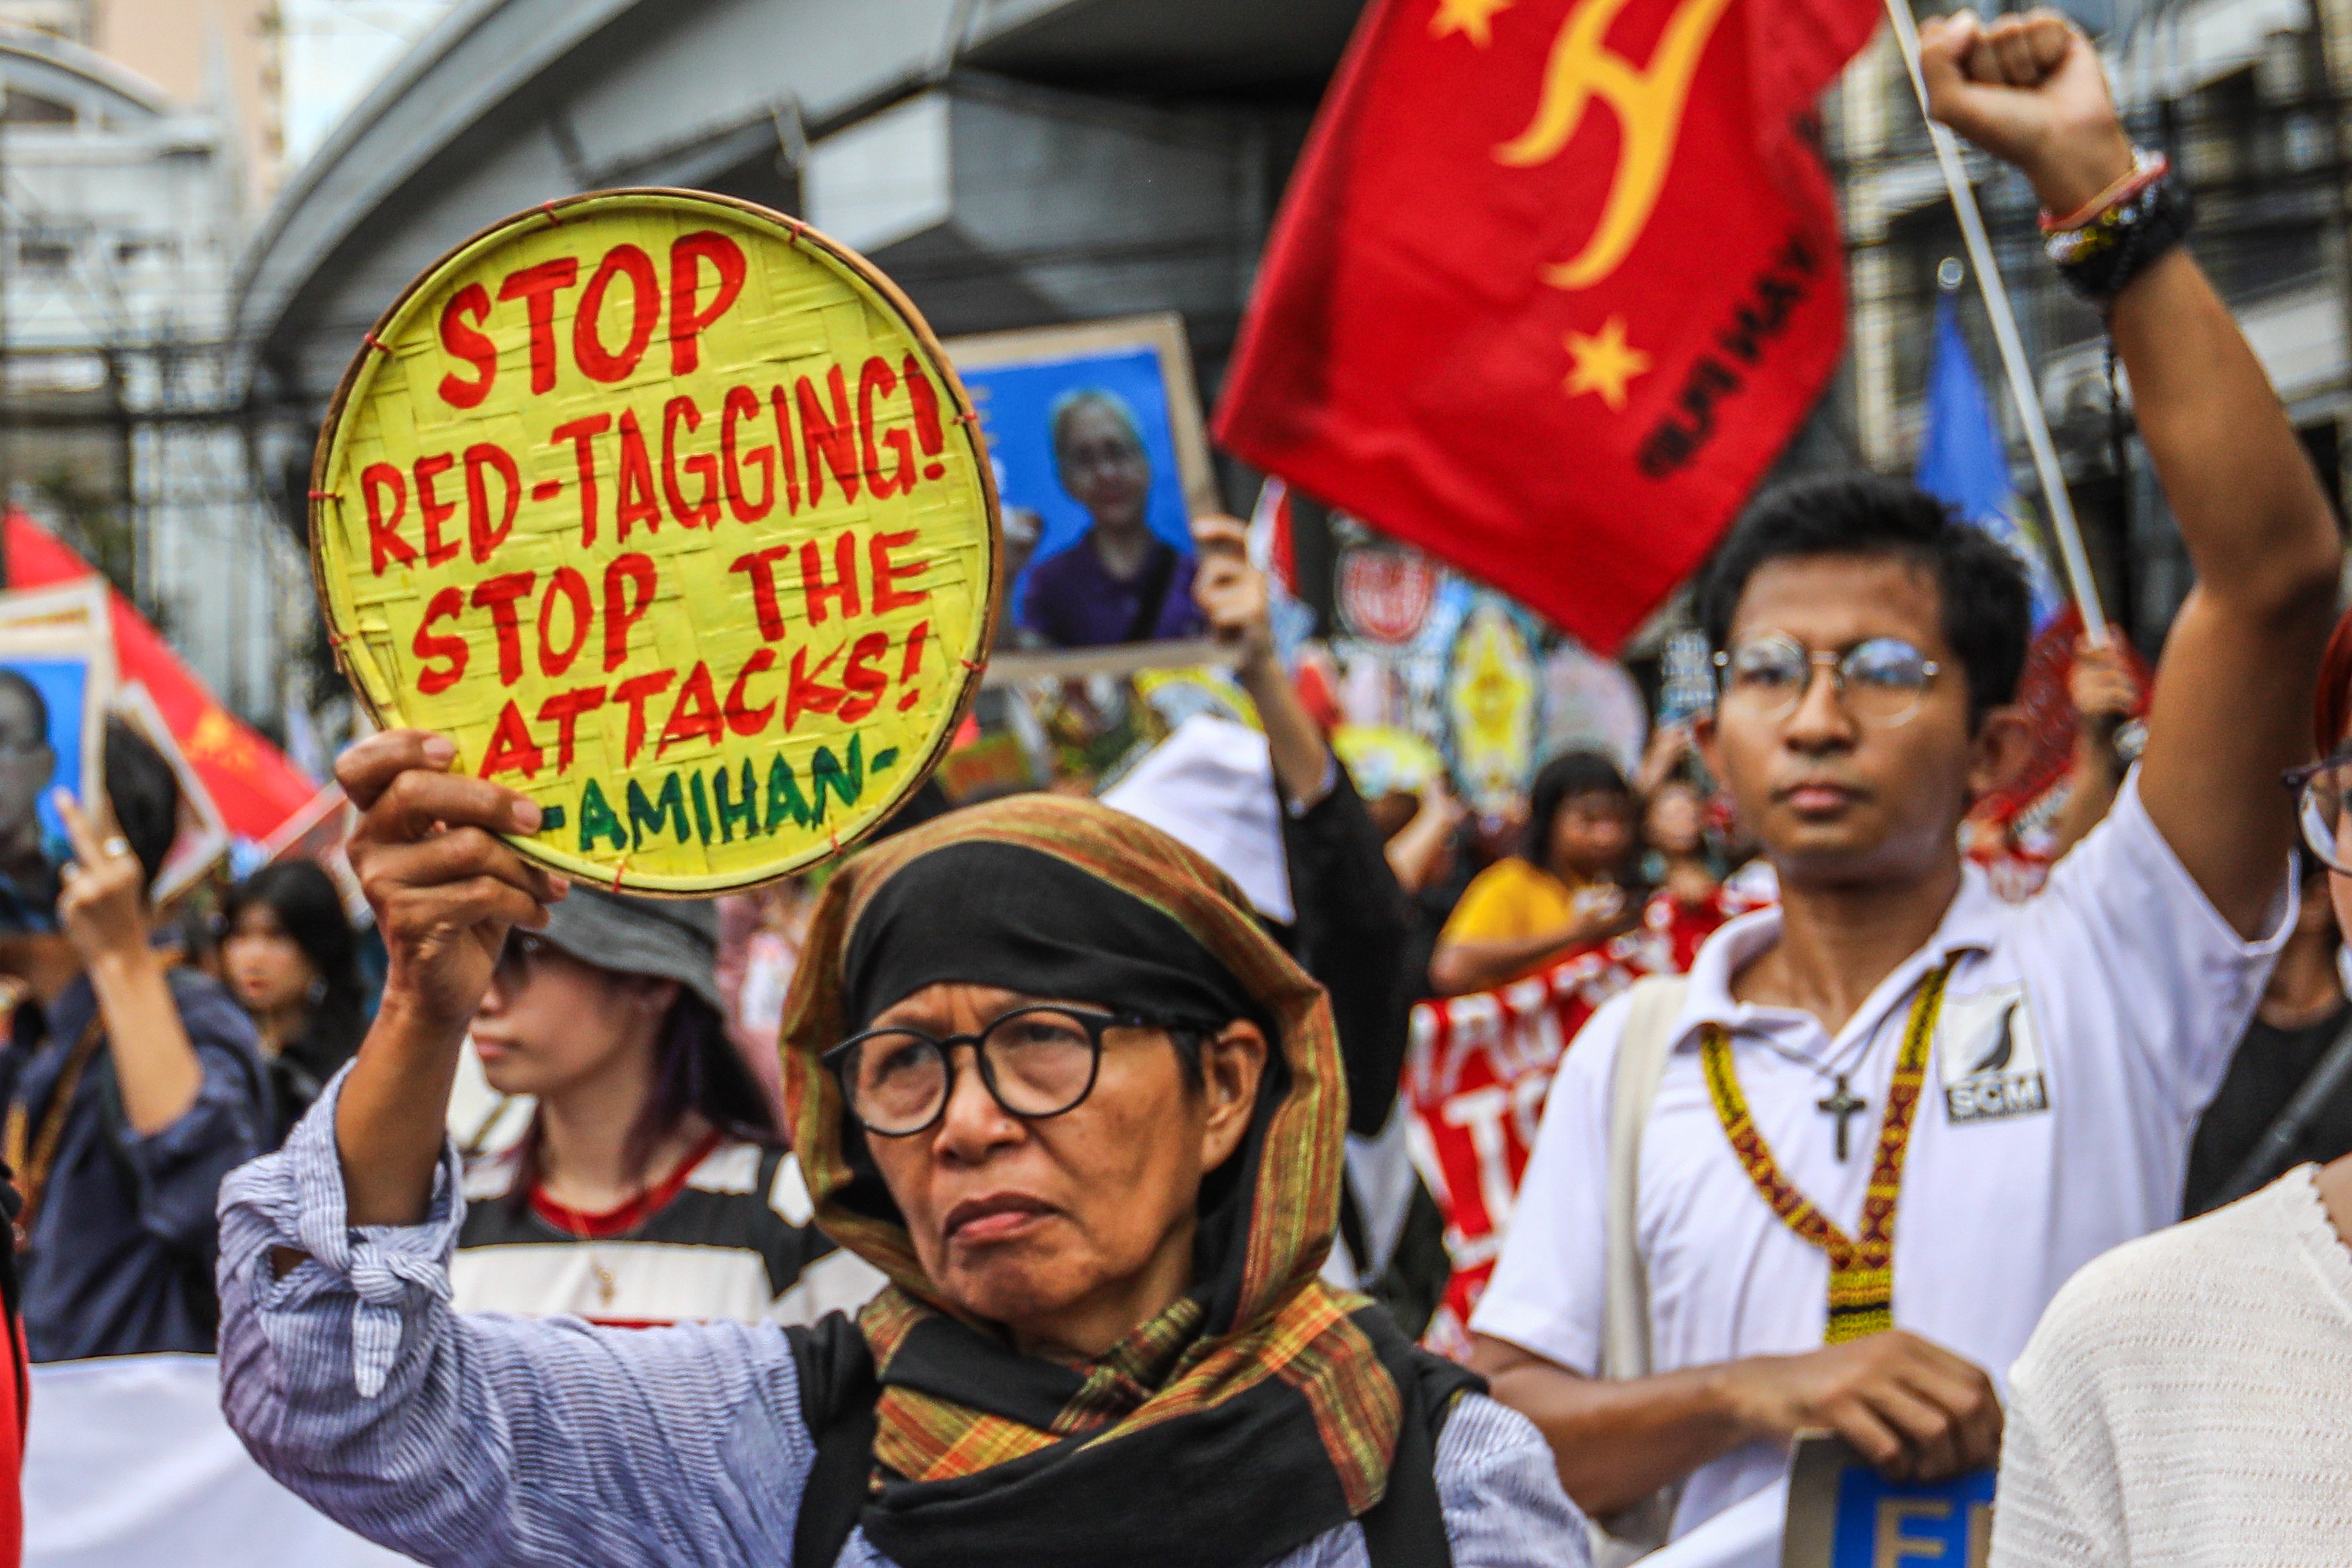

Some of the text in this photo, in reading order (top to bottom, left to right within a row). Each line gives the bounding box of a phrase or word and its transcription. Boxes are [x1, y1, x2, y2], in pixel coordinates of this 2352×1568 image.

[438, 230, 746, 409] STOP
[361, 353, 946, 576] RED-TAGGING!
[413, 529, 932, 695] STOP THE
[478, 620, 929, 780] ATTACKS!
